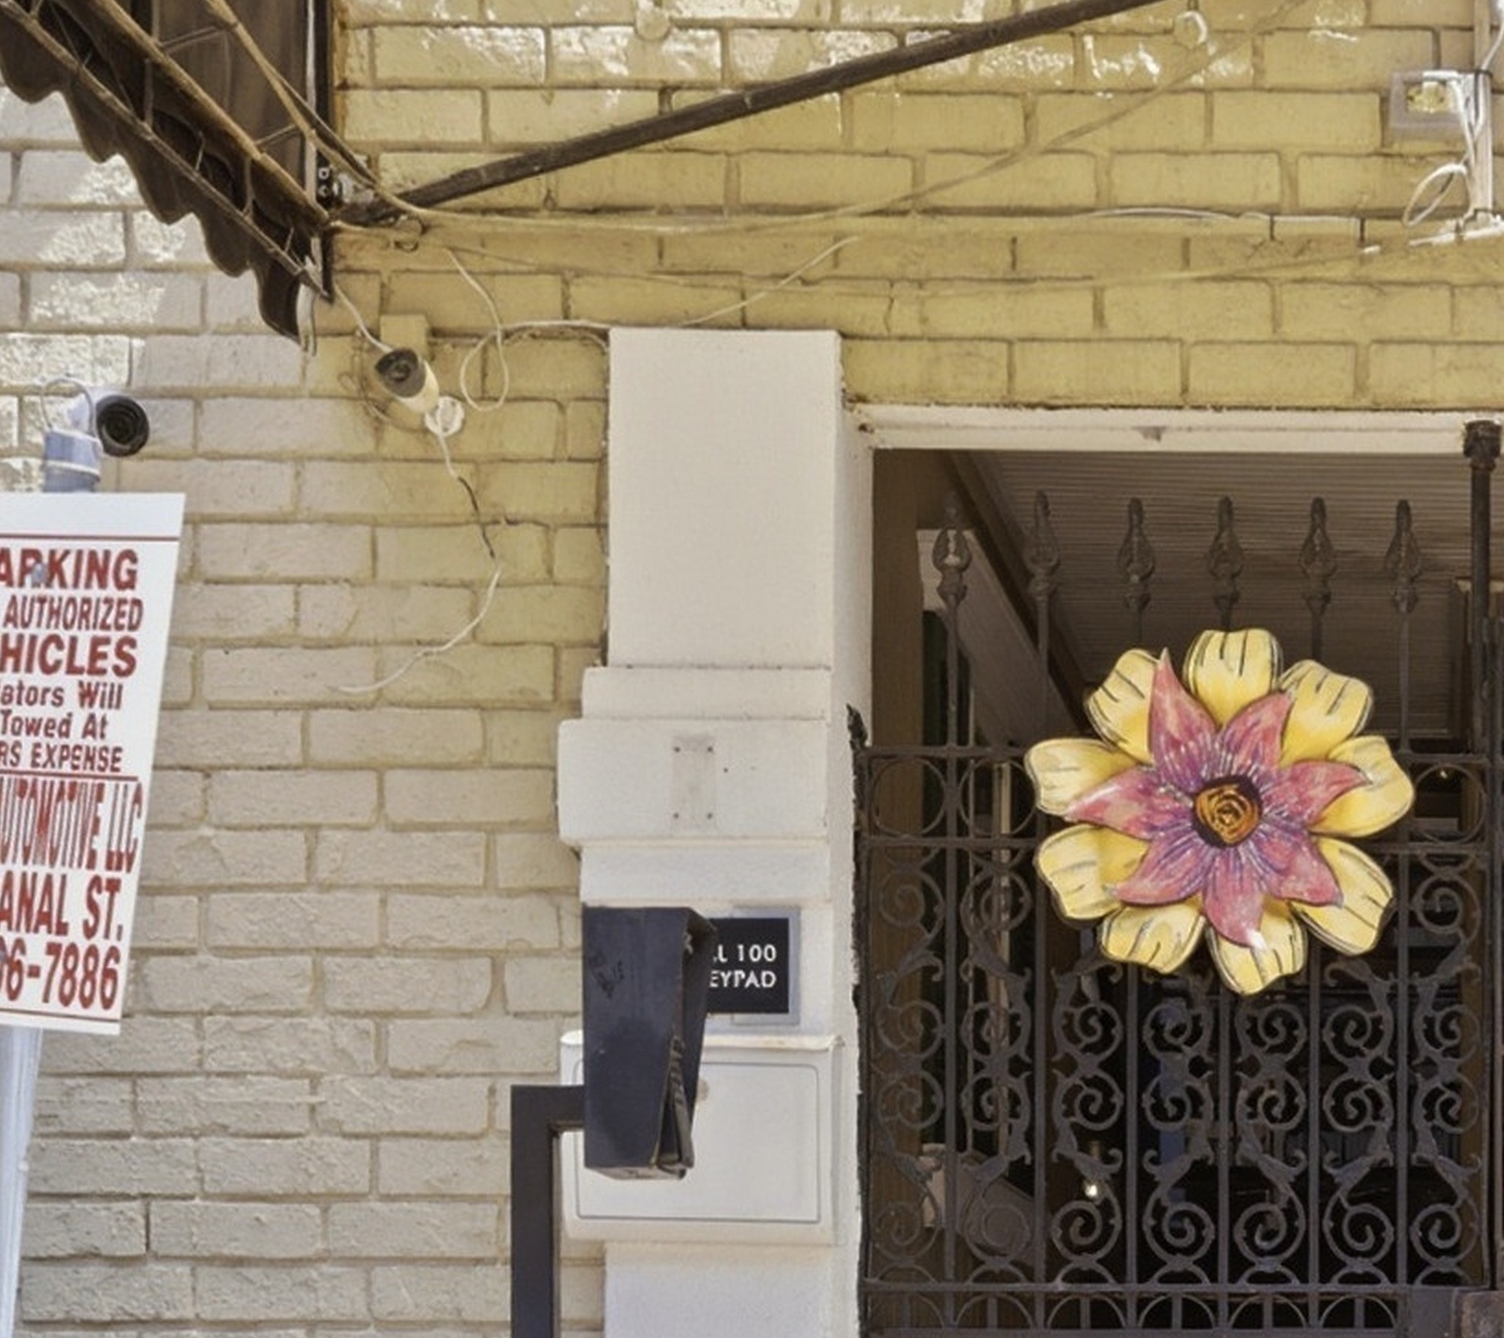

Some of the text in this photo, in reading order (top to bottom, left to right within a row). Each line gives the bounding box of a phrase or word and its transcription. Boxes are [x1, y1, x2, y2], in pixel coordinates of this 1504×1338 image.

[3, 595, 144, 632] AUTHORIZED
[77, 679, 124, 710] Will
[0, 709, 73, 739] Towed
[82, 713, 108, 740] At
[30, 742, 124, 773] EXPENSE
[104, 781, 144, 874] LLC
[82, 874, 124, 942] ST.
[737, 943, 778, 963] 100
